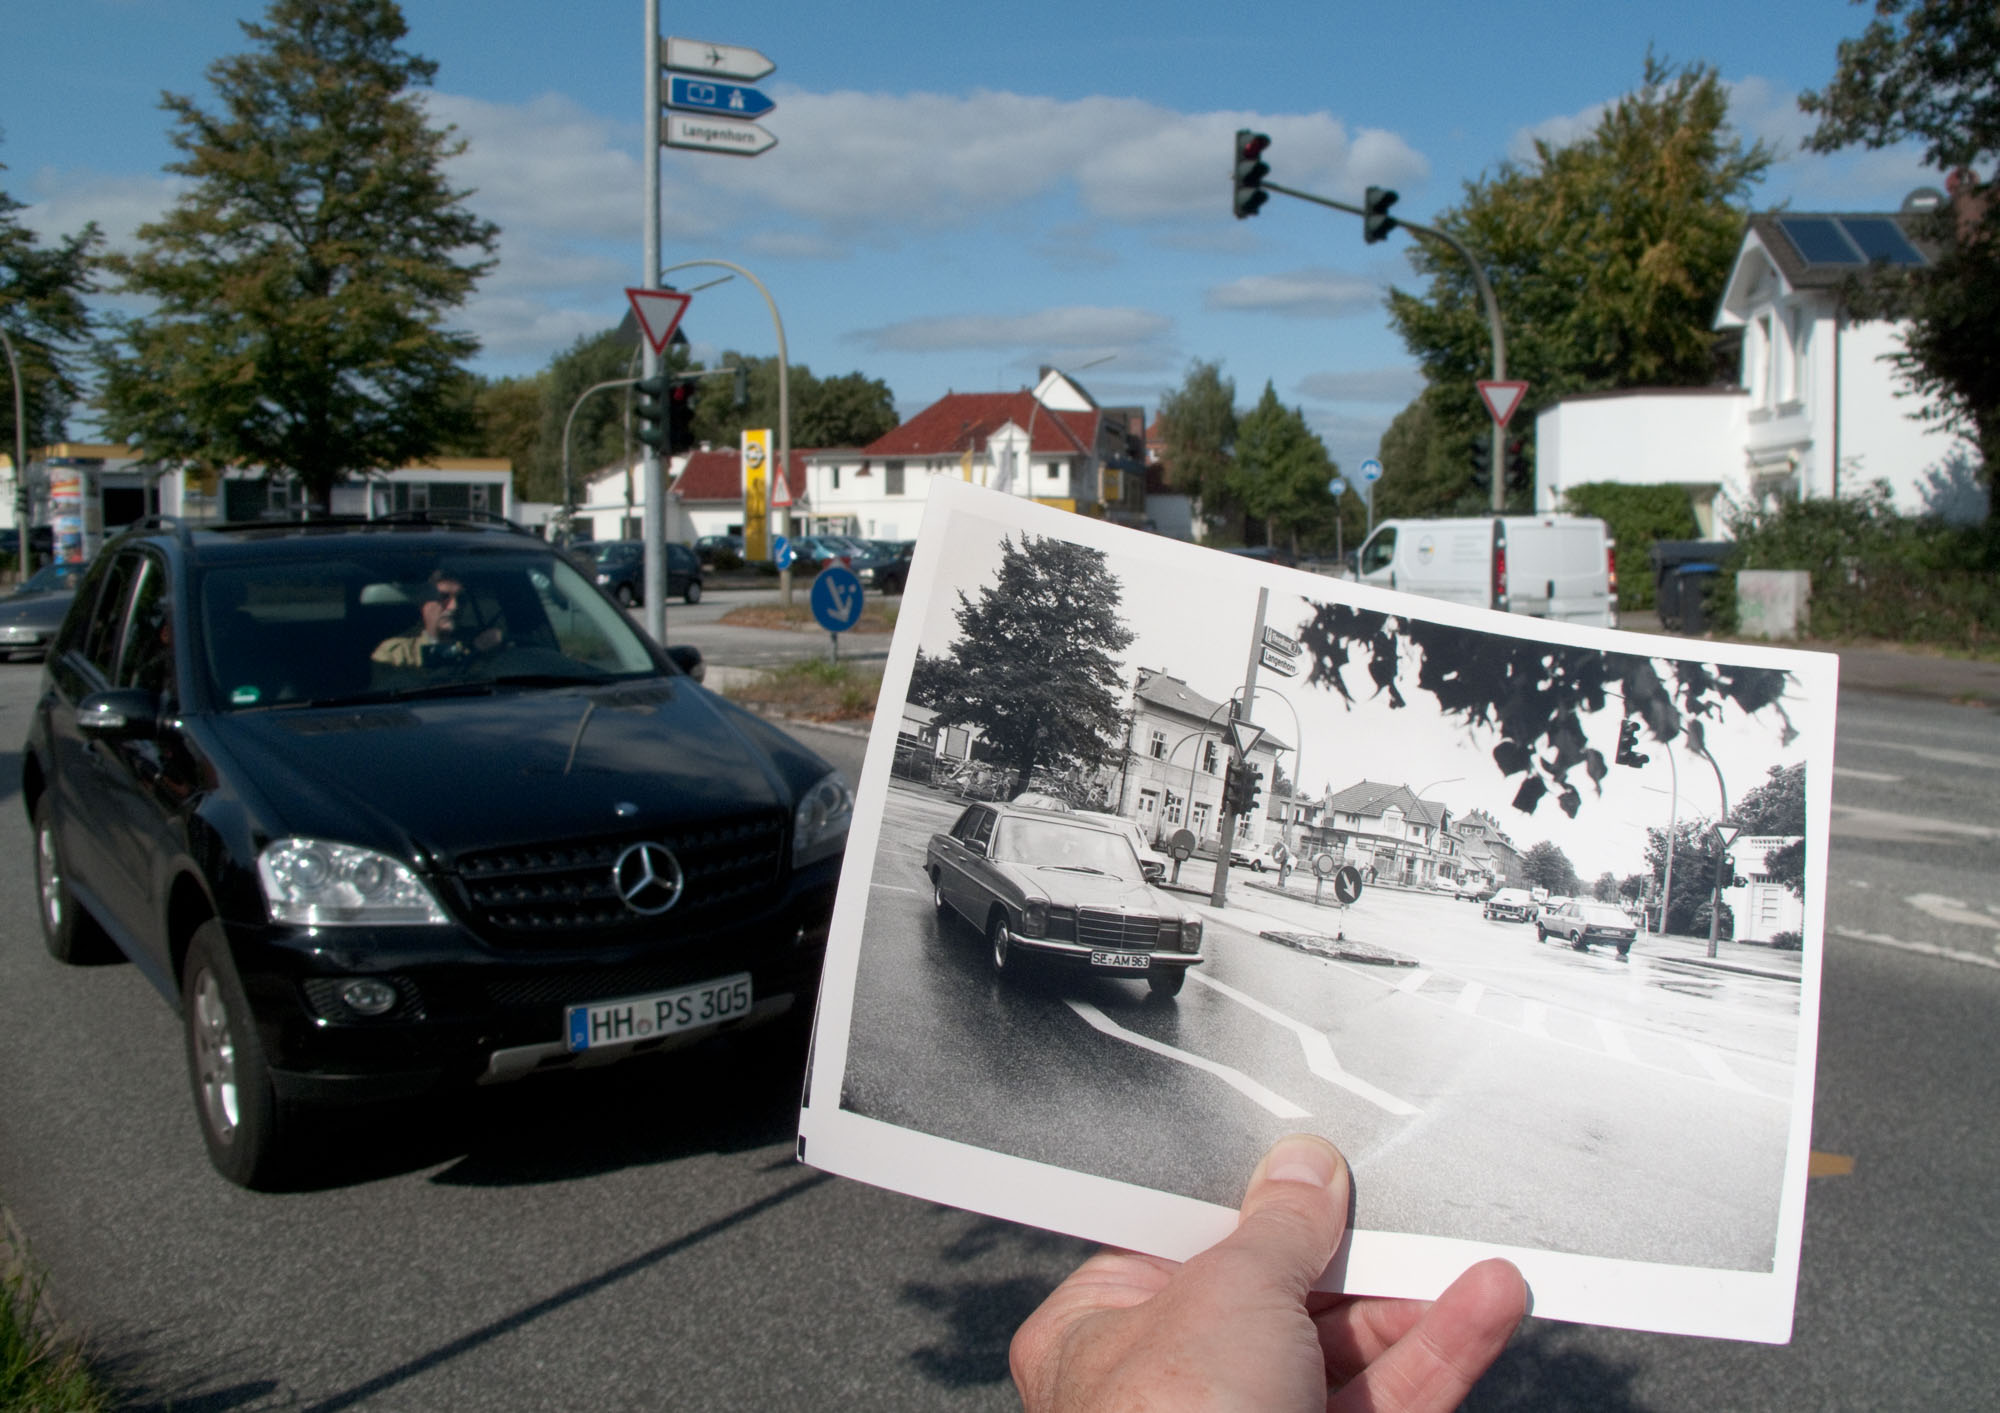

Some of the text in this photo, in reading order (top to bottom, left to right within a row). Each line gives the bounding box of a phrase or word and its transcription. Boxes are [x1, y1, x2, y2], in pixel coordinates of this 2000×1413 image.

[682, 121, 756, 143] Langenhorn
[1265, 651, 1296, 672] Langenhorn
[592, 981, 748, 1042] HH PS 305
